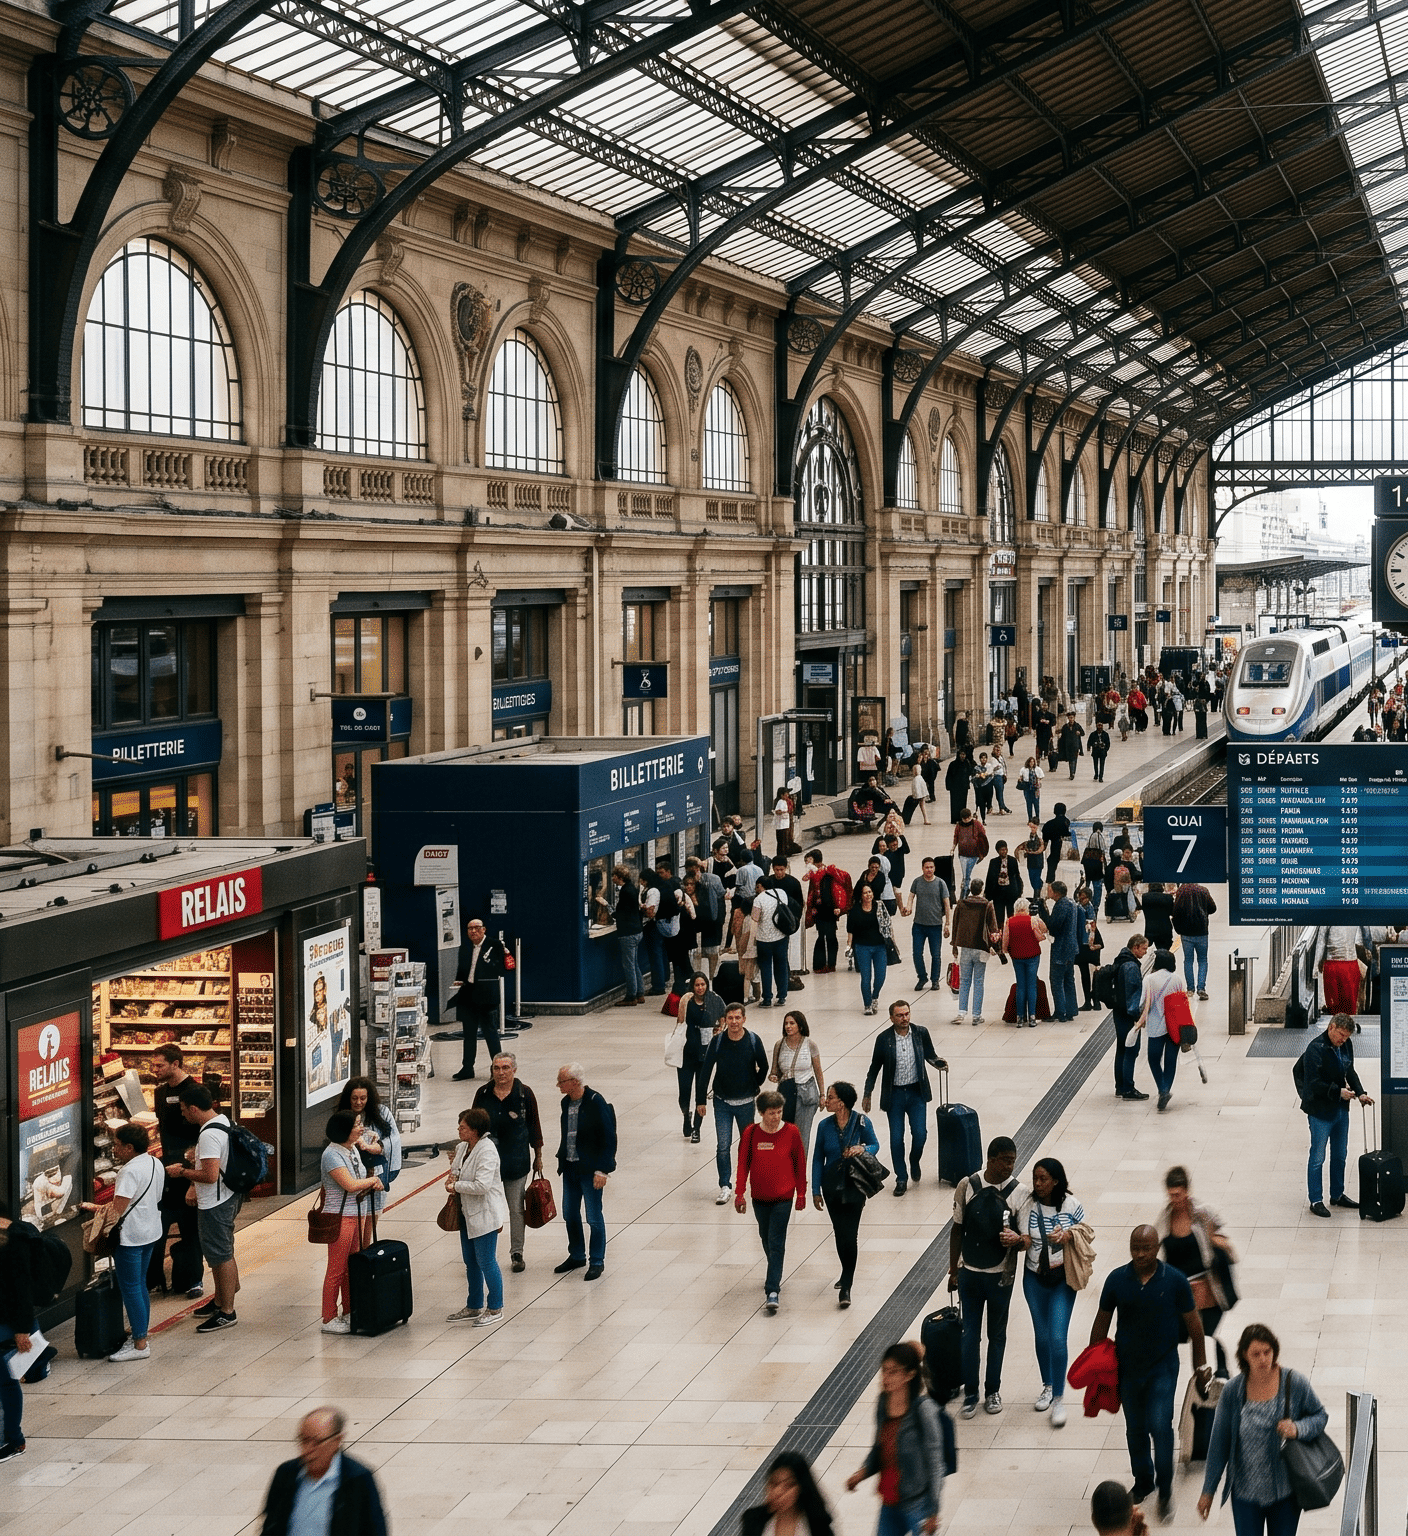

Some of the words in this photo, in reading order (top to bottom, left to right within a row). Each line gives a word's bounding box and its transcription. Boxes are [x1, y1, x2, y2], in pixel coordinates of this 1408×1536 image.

[112, 738, 185, 764] BILLETTERIE
[610, 752, 684, 791] BILLETTERIE
[1167, 815, 1202, 827] QUAI
[1171, 834, 1198, 873] 7
[181, 877, 246, 928] RELAIS
